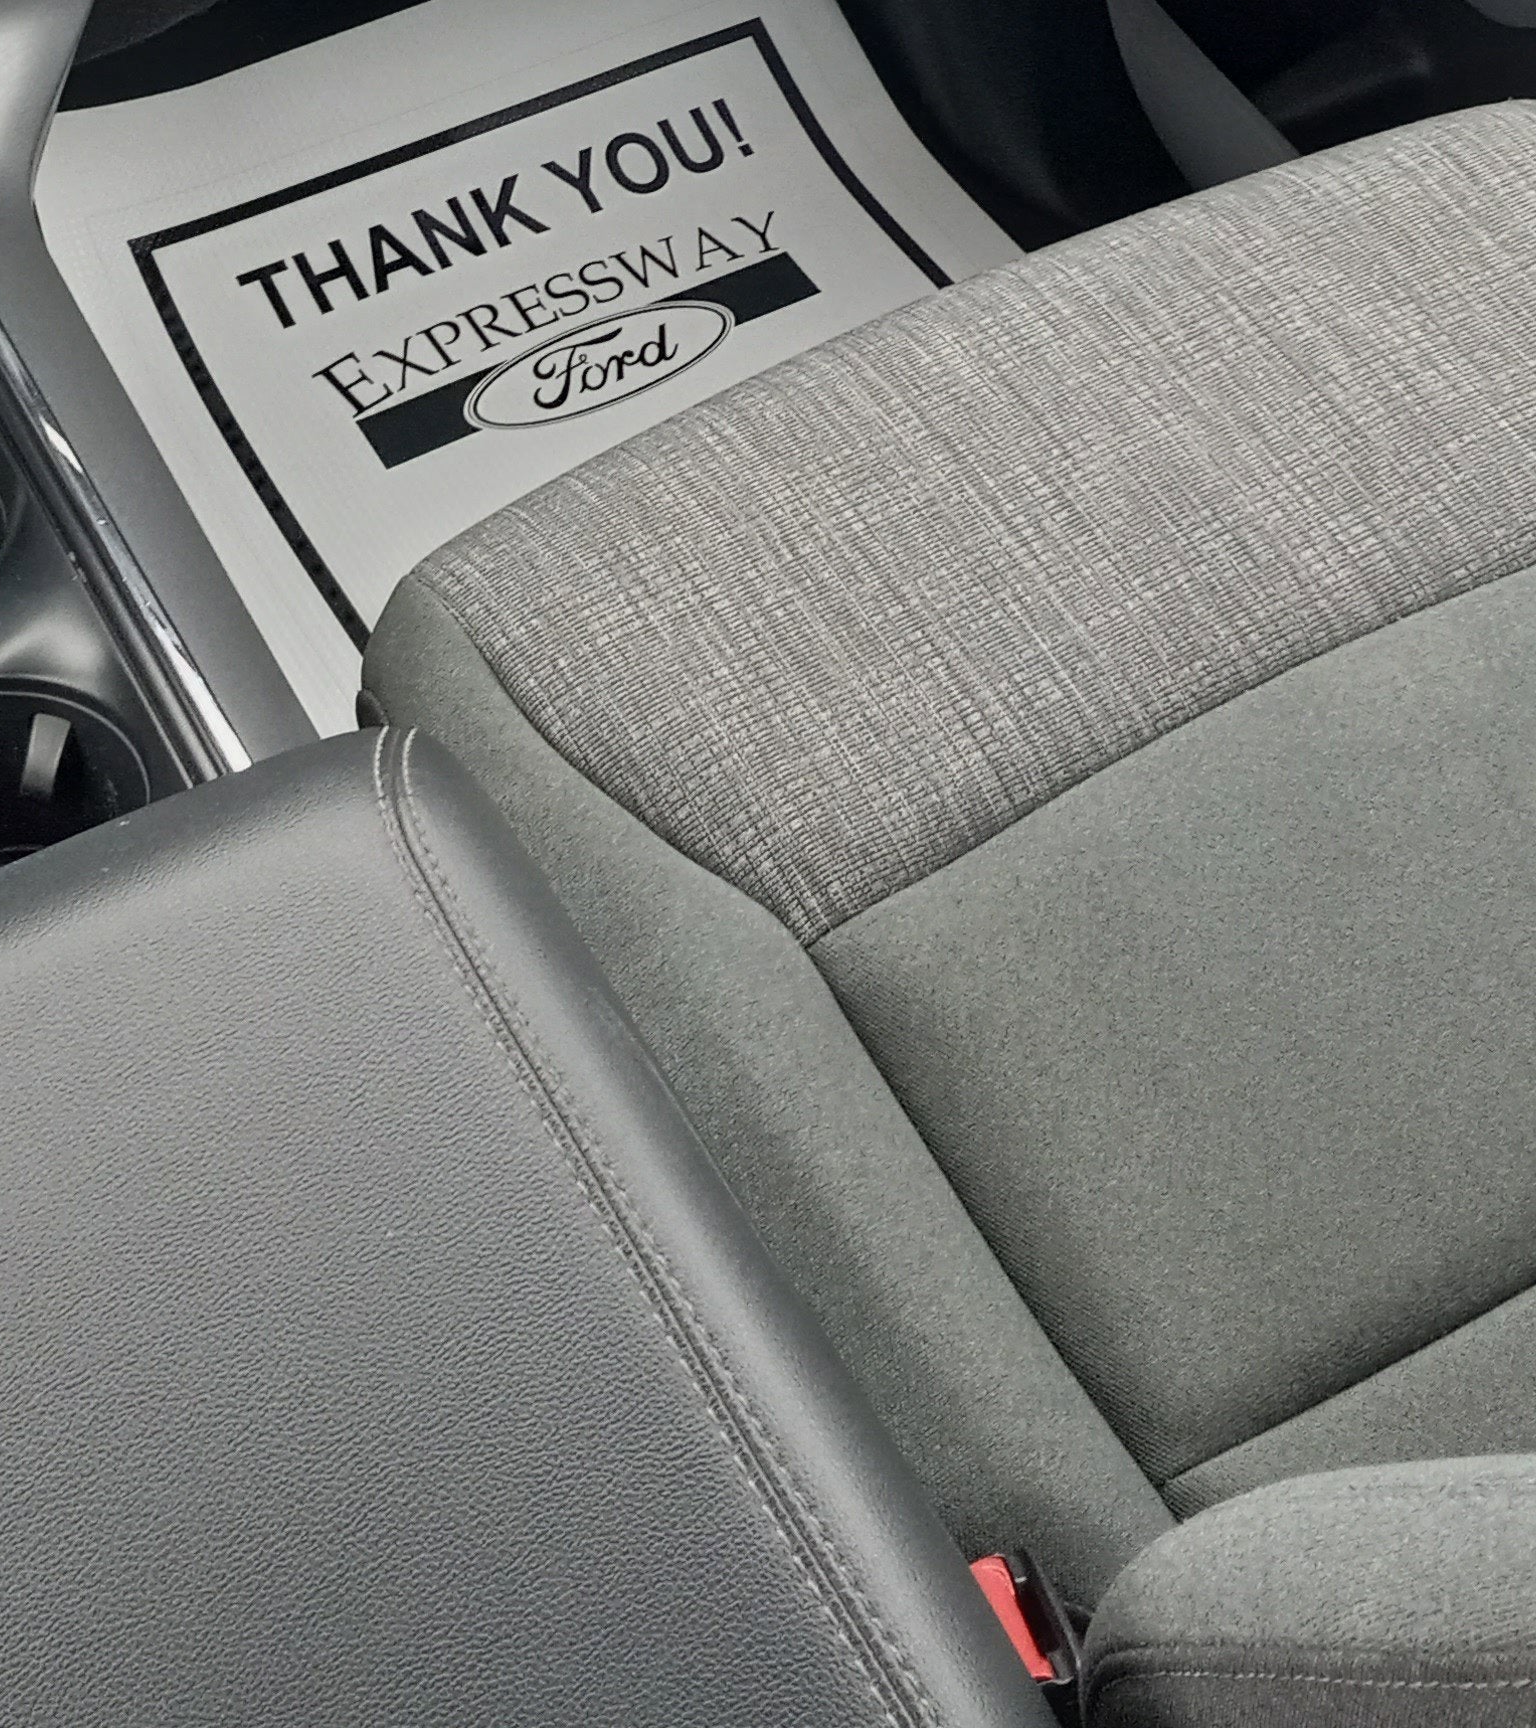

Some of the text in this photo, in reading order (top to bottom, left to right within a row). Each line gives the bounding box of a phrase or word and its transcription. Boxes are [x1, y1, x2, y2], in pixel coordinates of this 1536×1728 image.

[236, 97, 756, 330] THANK YOU!
[312, 210, 782, 418] EXPRESSWAY
[531, 324, 681, 411] Ford
